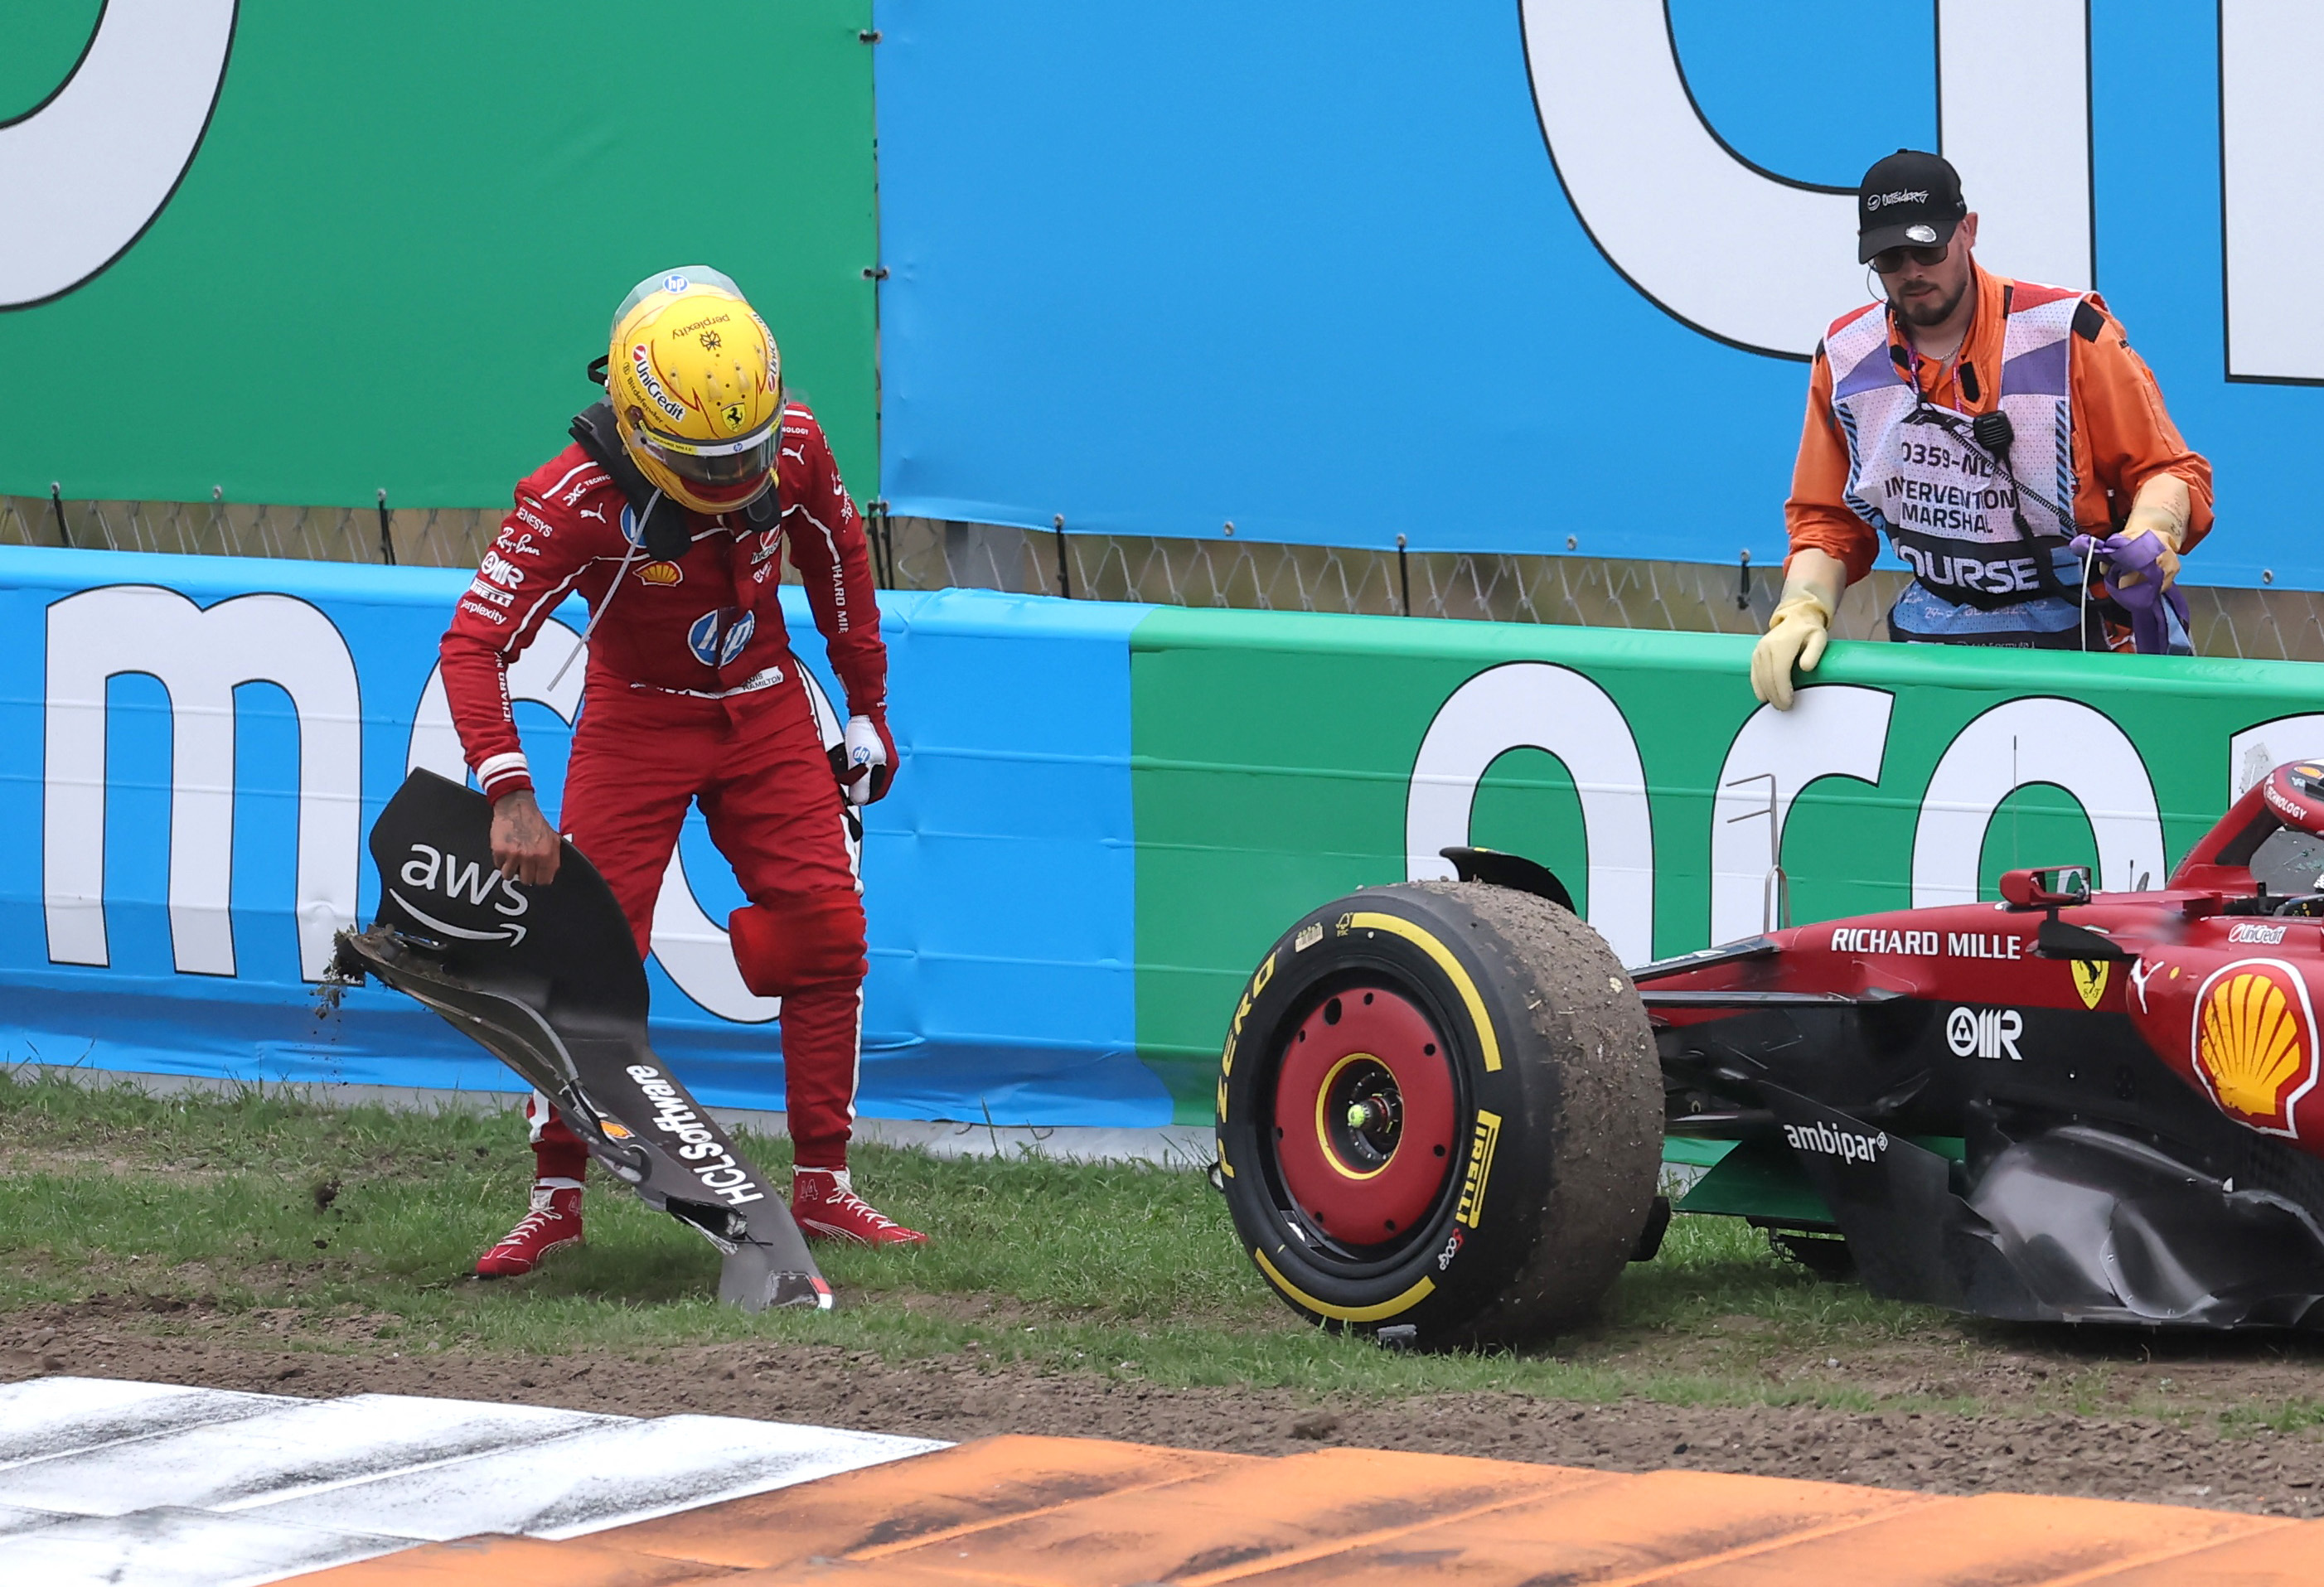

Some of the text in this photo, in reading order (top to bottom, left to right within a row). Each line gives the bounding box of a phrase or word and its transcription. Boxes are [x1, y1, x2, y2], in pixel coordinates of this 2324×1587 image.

[666, 276, 685, 290] hp
[672, 313, 731, 341] perplexity
[636, 360, 685, 422] UniCredit
[1884, 476, 2016, 510] INERVENTON
[1901, 501, 1994, 534] MARSHAL
[1897, 544, 2041, 594] OURSE
[400, 844, 530, 917] aws
[1831, 928, 2021, 960] RICHARD MILLE
[1784, 1121, 1876, 1164] ambipar
[1456, 1109, 1502, 1231] PIRELLI
